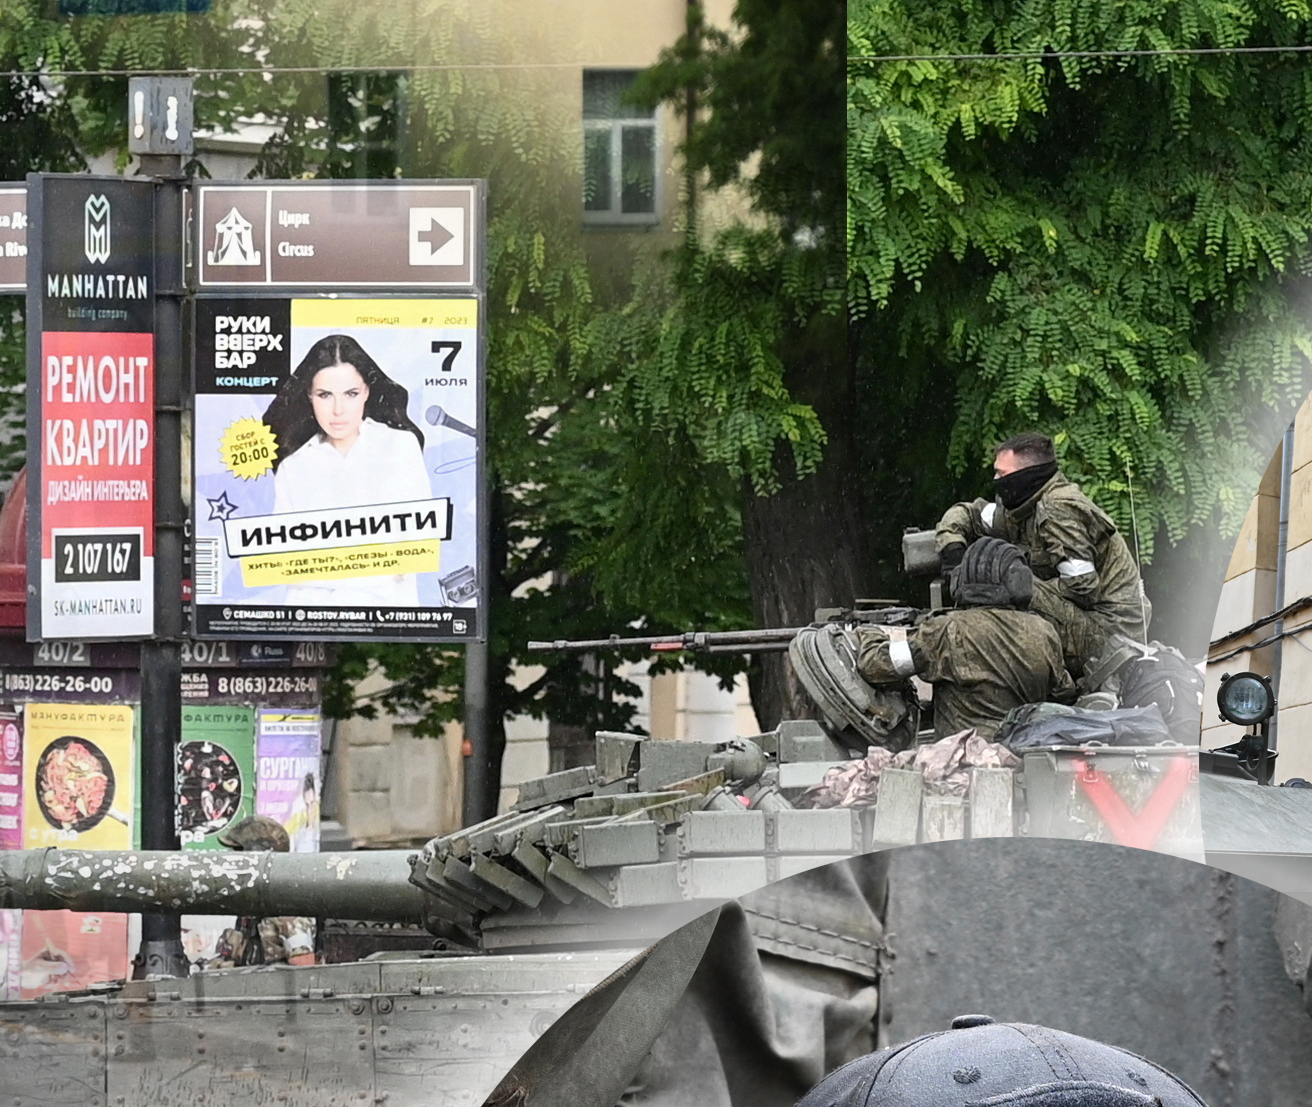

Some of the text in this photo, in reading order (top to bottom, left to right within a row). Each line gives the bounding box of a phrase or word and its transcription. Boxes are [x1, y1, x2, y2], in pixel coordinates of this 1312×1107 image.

[279, 210, 310, 228] Цирк
[278, 241, 315, 257] Circus
[47, 274, 147, 299] MANHATTAN
[68, 307, 128, 321] building company
[356, 316, 400, 325] ПЯТНИЦА
[444, 317, 467, 325] 2023
[215, 316, 270, 333] РУКИ
[215, 333, 283, 351] ВВЕРХ
[215, 351, 256, 369] БАР
[431, 341, 462, 372] 7
[47, 355, 148, 403] РЕМОНТ
[216, 377, 279, 388] КОНЦЕРТ
[425, 378, 468, 387] ИЮЛЯ
[46, 418, 149, 466] КВАРТИР
[230, 438, 259, 452] ГОСТЕЙ
[236, 431, 255, 442] СБОР
[231, 447, 269, 466] 20:00
[47, 476, 148, 506] ДИЗАЙН ИНТЕРЬЕРА
[241, 510, 437, 547] ИНФИНИТИ
[64, 542, 131, 574] 2 107 167
[54, 599, 142, 617] SK-MANHATTAN.RU
[276, 610, 285, 620] 51
[385, 612, 395, 620] +7
[396, 612, 415, 621] (931)
[38, 642, 86, 663] 40/2
[296, 642, 326, 663] 40/8
[31, 711, 125, 723] МАНУФАКТУРА
[183, 714, 249, 724] ФАКТУРА
